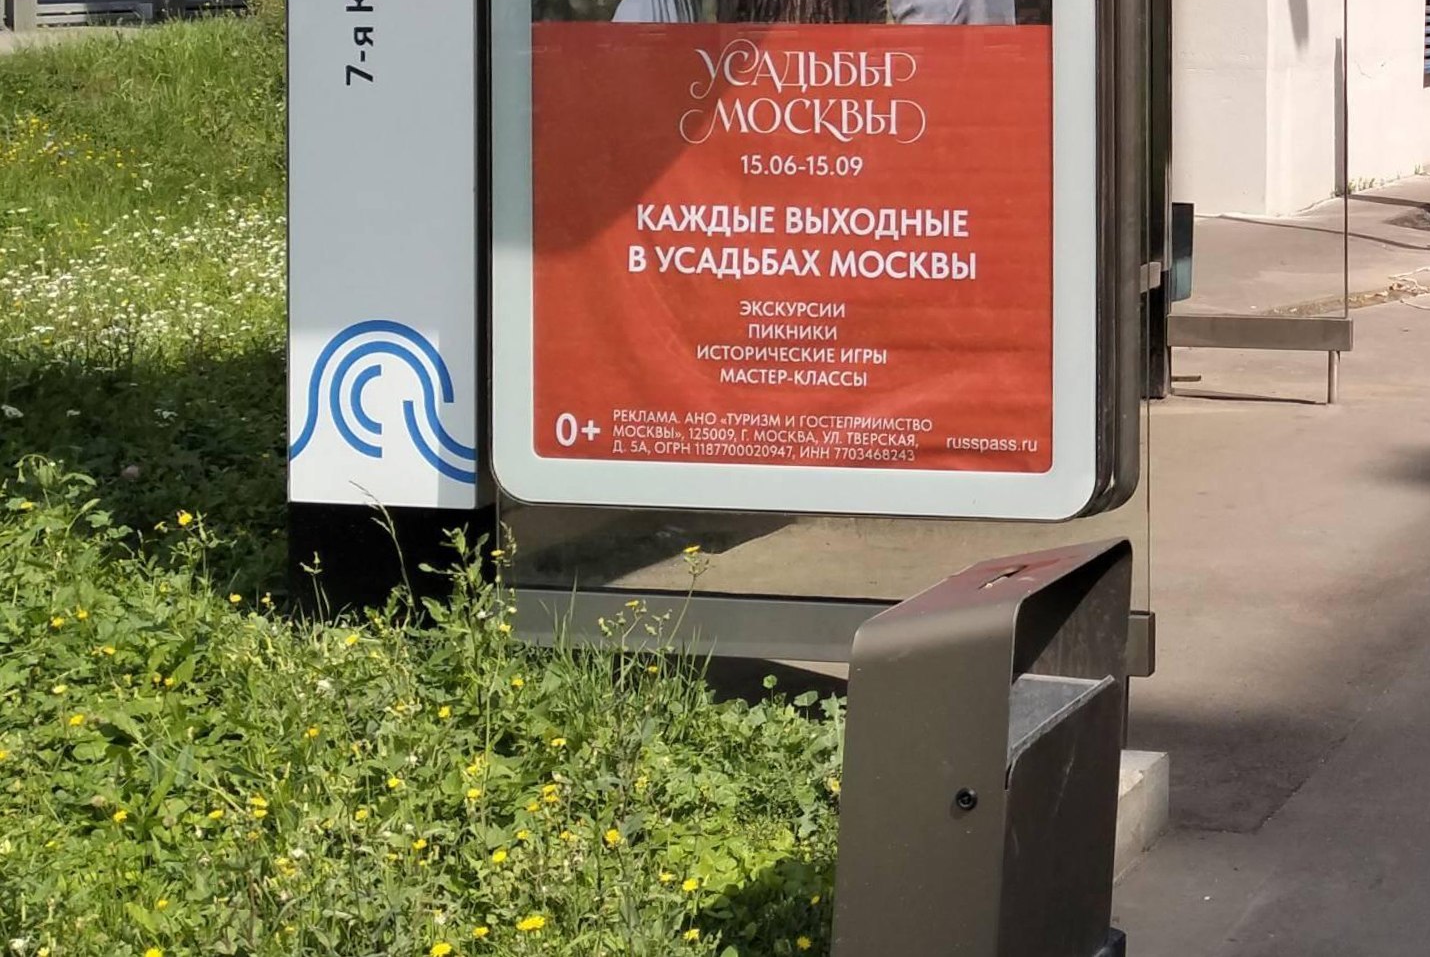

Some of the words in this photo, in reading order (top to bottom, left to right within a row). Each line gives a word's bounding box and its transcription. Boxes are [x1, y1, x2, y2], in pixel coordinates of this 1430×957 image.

[346, 27, 374, 86] 7-я
[690, 38, 917, 99] УСАДЬБЫ
[679, 97, 926, 143] МОСКВЫ
[740, 154, 864, 176] 15.06-15.09
[636, 204, 775, 237] КАЖДЫЕ
[785, 206, 970, 240] ВЫХОДНЫЕ
[627, 245, 648, 273] В
[655, 246, 821, 279] УСАДЬБАХ
[829, 249, 976, 280] МОСКВЫ
[739, 300, 846, 318] ЭКСКУРСИИ
[747, 323, 838, 340] ПИКНИКИ
[696, 344, 836, 363] ИСТОРИЧЕСКИЕ
[840, 348, 888, 365] ИГРЫ
[719, 368, 868, 387] МАСТЕР-КЛАССЫ
[555, 412, 601, 447] 0+
[612, 409, 681, 425] РЕКЛАМА.
[683, 412, 718, 426] АНО
[720, 413, 782, 427] «ТУРИЗМ
[784, 416, 796, 427] И
[799, 415, 933, 432] ГОСТЕПРИИМСТВО
[612, 425, 685, 442] МОСКВЫ»,
[688, 427, 737, 442] 125009,
[740, 429, 750, 441] Г.
[753, 430, 818, 444] МОСКВА,
[822, 431, 843, 444] УЛ.
[846, 432, 920, 449] ТВЕРСКАЯ,
[945, 436, 1038, 454] russpass.ru
[612, 441, 627, 455] Д.
[629, 441, 651, 457] 5А,
[653, 442, 691, 455] ОГРН
[694, 443, 797, 460] 1187700020947,
[799, 447, 831, 460] ИНН
[834, 447, 917, 462] 7703468243
